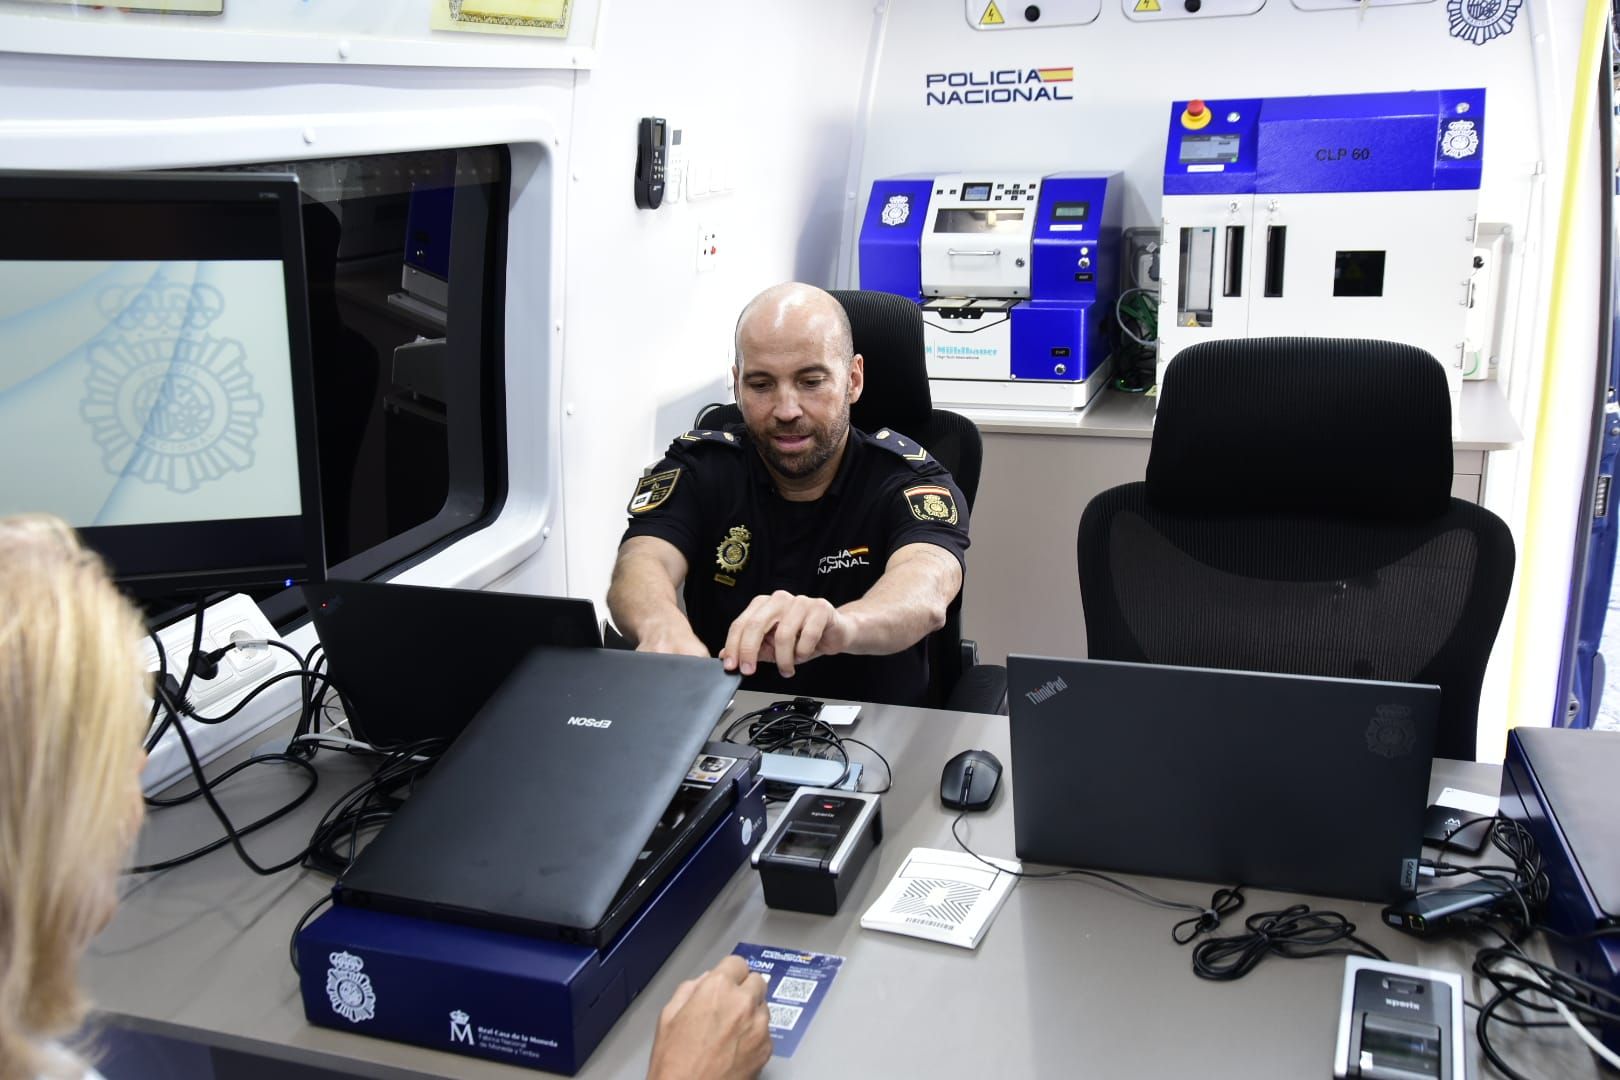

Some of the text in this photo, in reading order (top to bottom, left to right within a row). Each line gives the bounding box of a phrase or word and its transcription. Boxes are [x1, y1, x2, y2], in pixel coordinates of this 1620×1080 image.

[926, 86, 1073, 106] NACIONAL
[1316, 148, 1370, 161] CLP 60
[1025, 676, 1068, 705] ThinkPad
[567, 716, 612, 729] EPSON
[478, 1026, 558, 1048] Real Casa de la Moneda
